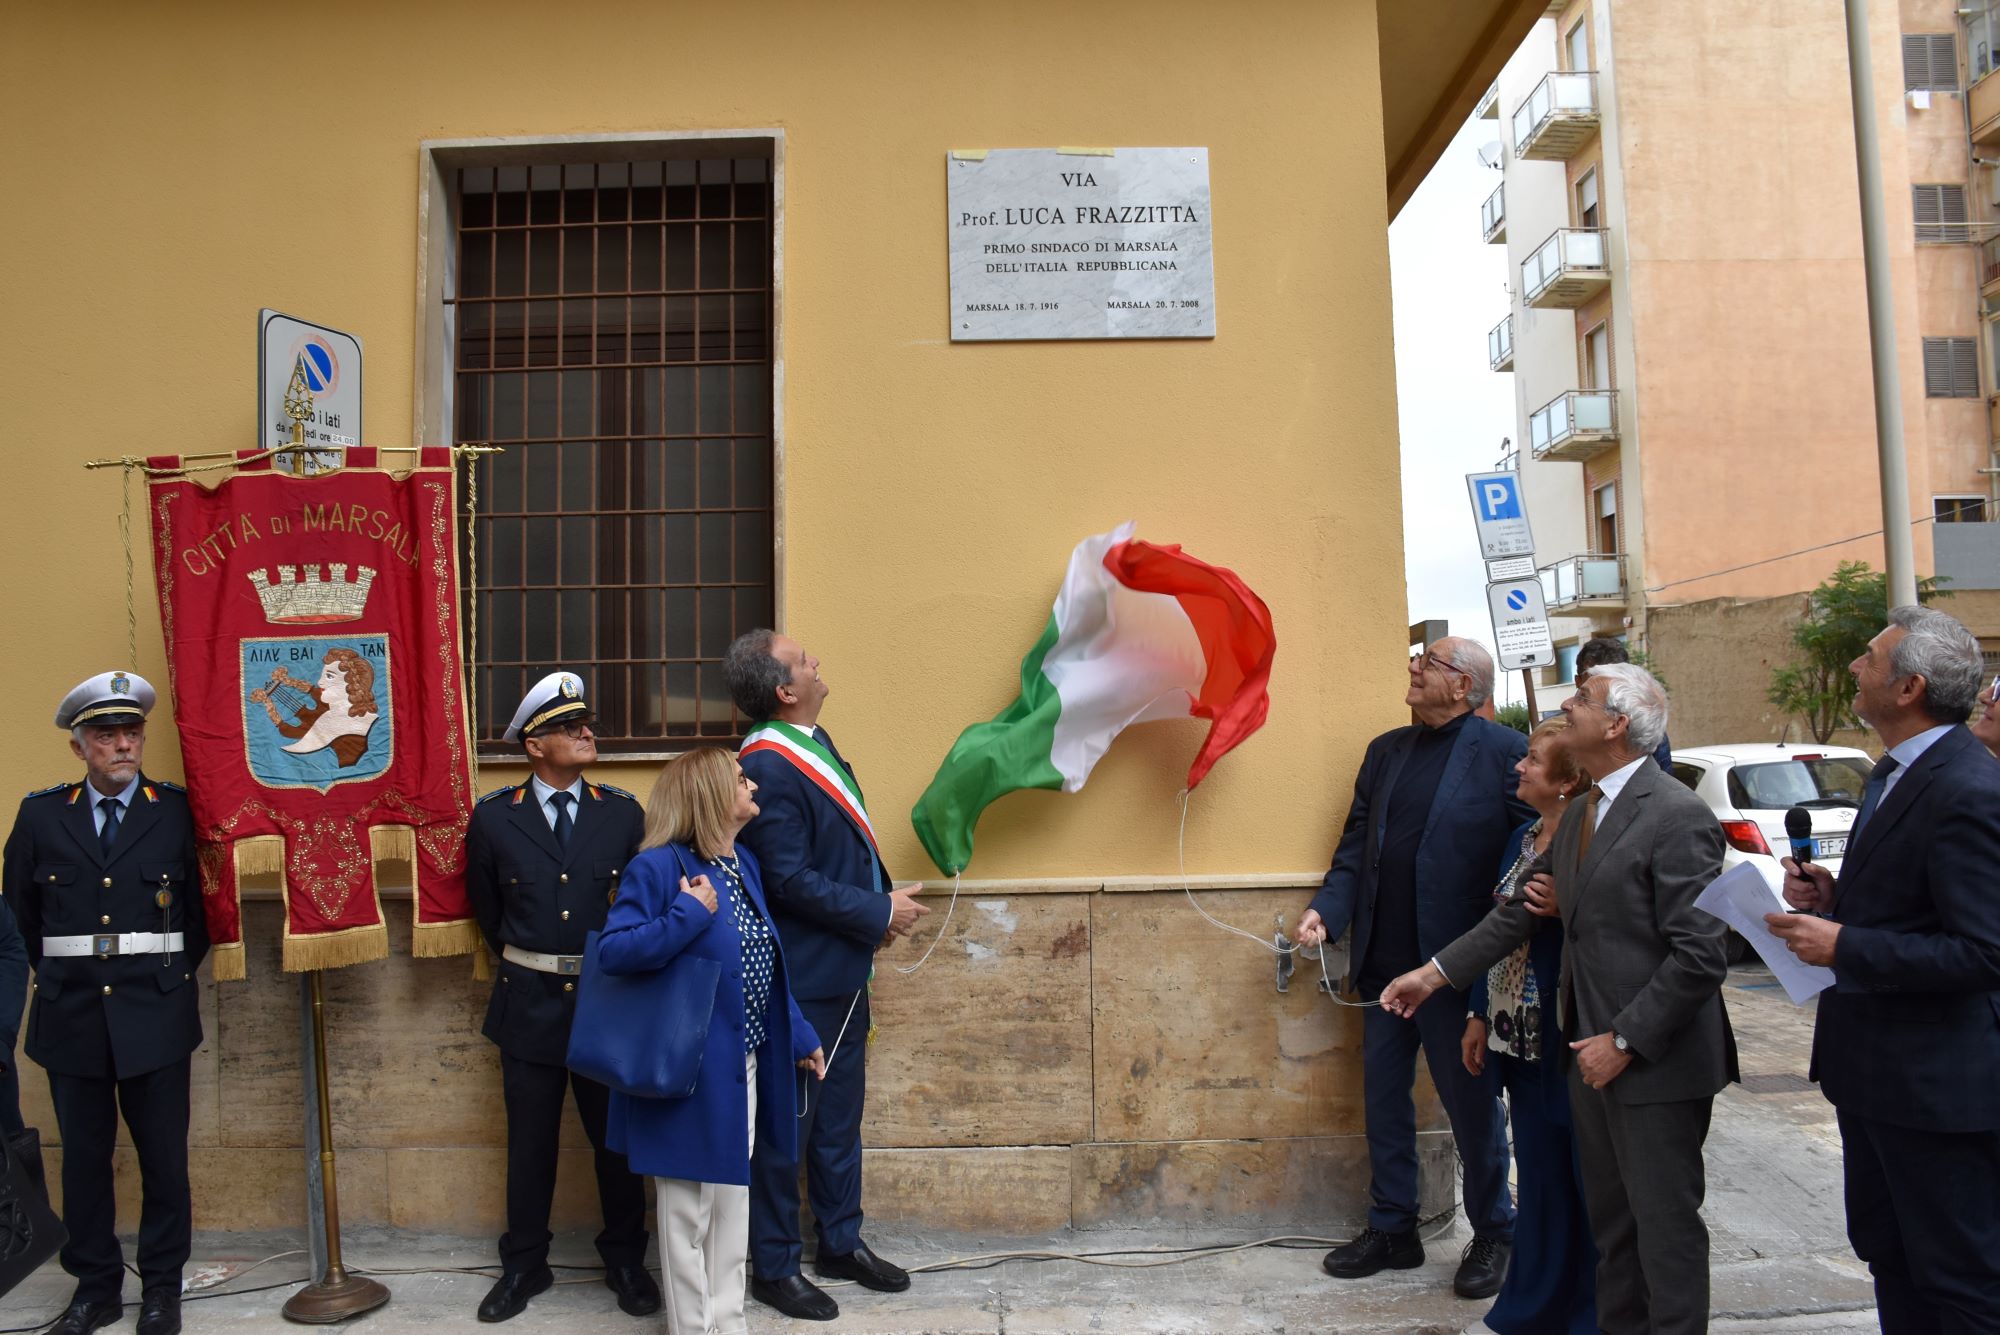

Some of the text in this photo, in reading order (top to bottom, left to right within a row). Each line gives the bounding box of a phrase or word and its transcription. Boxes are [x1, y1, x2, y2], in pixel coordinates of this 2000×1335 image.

[1060, 172, 1098, 187] VIA
[962, 205, 1198, 226] Prof. LUCA FRAZZITTA
[984, 241, 1178, 255] PRIMO SINDACO DI MARSALA
[986, 261, 1178, 274] DELL'ITALIA REPUBBLICANA
[966, 303, 1010, 312] MARSALA
[1040, 302, 1059, 311] 1916
[1107, 301, 1151, 310] MARSALA
[1181, 300, 1200, 309] 2008
[325, 411, 341, 428] lati
[276, 422, 286, 432] da
[320, 433, 331, 442] ore
[277, 453, 286, 463] da
[270, 516, 291, 534] DI
[303, 503, 422, 568] MARSALA
[1820, 840, 1834, 853] FF
